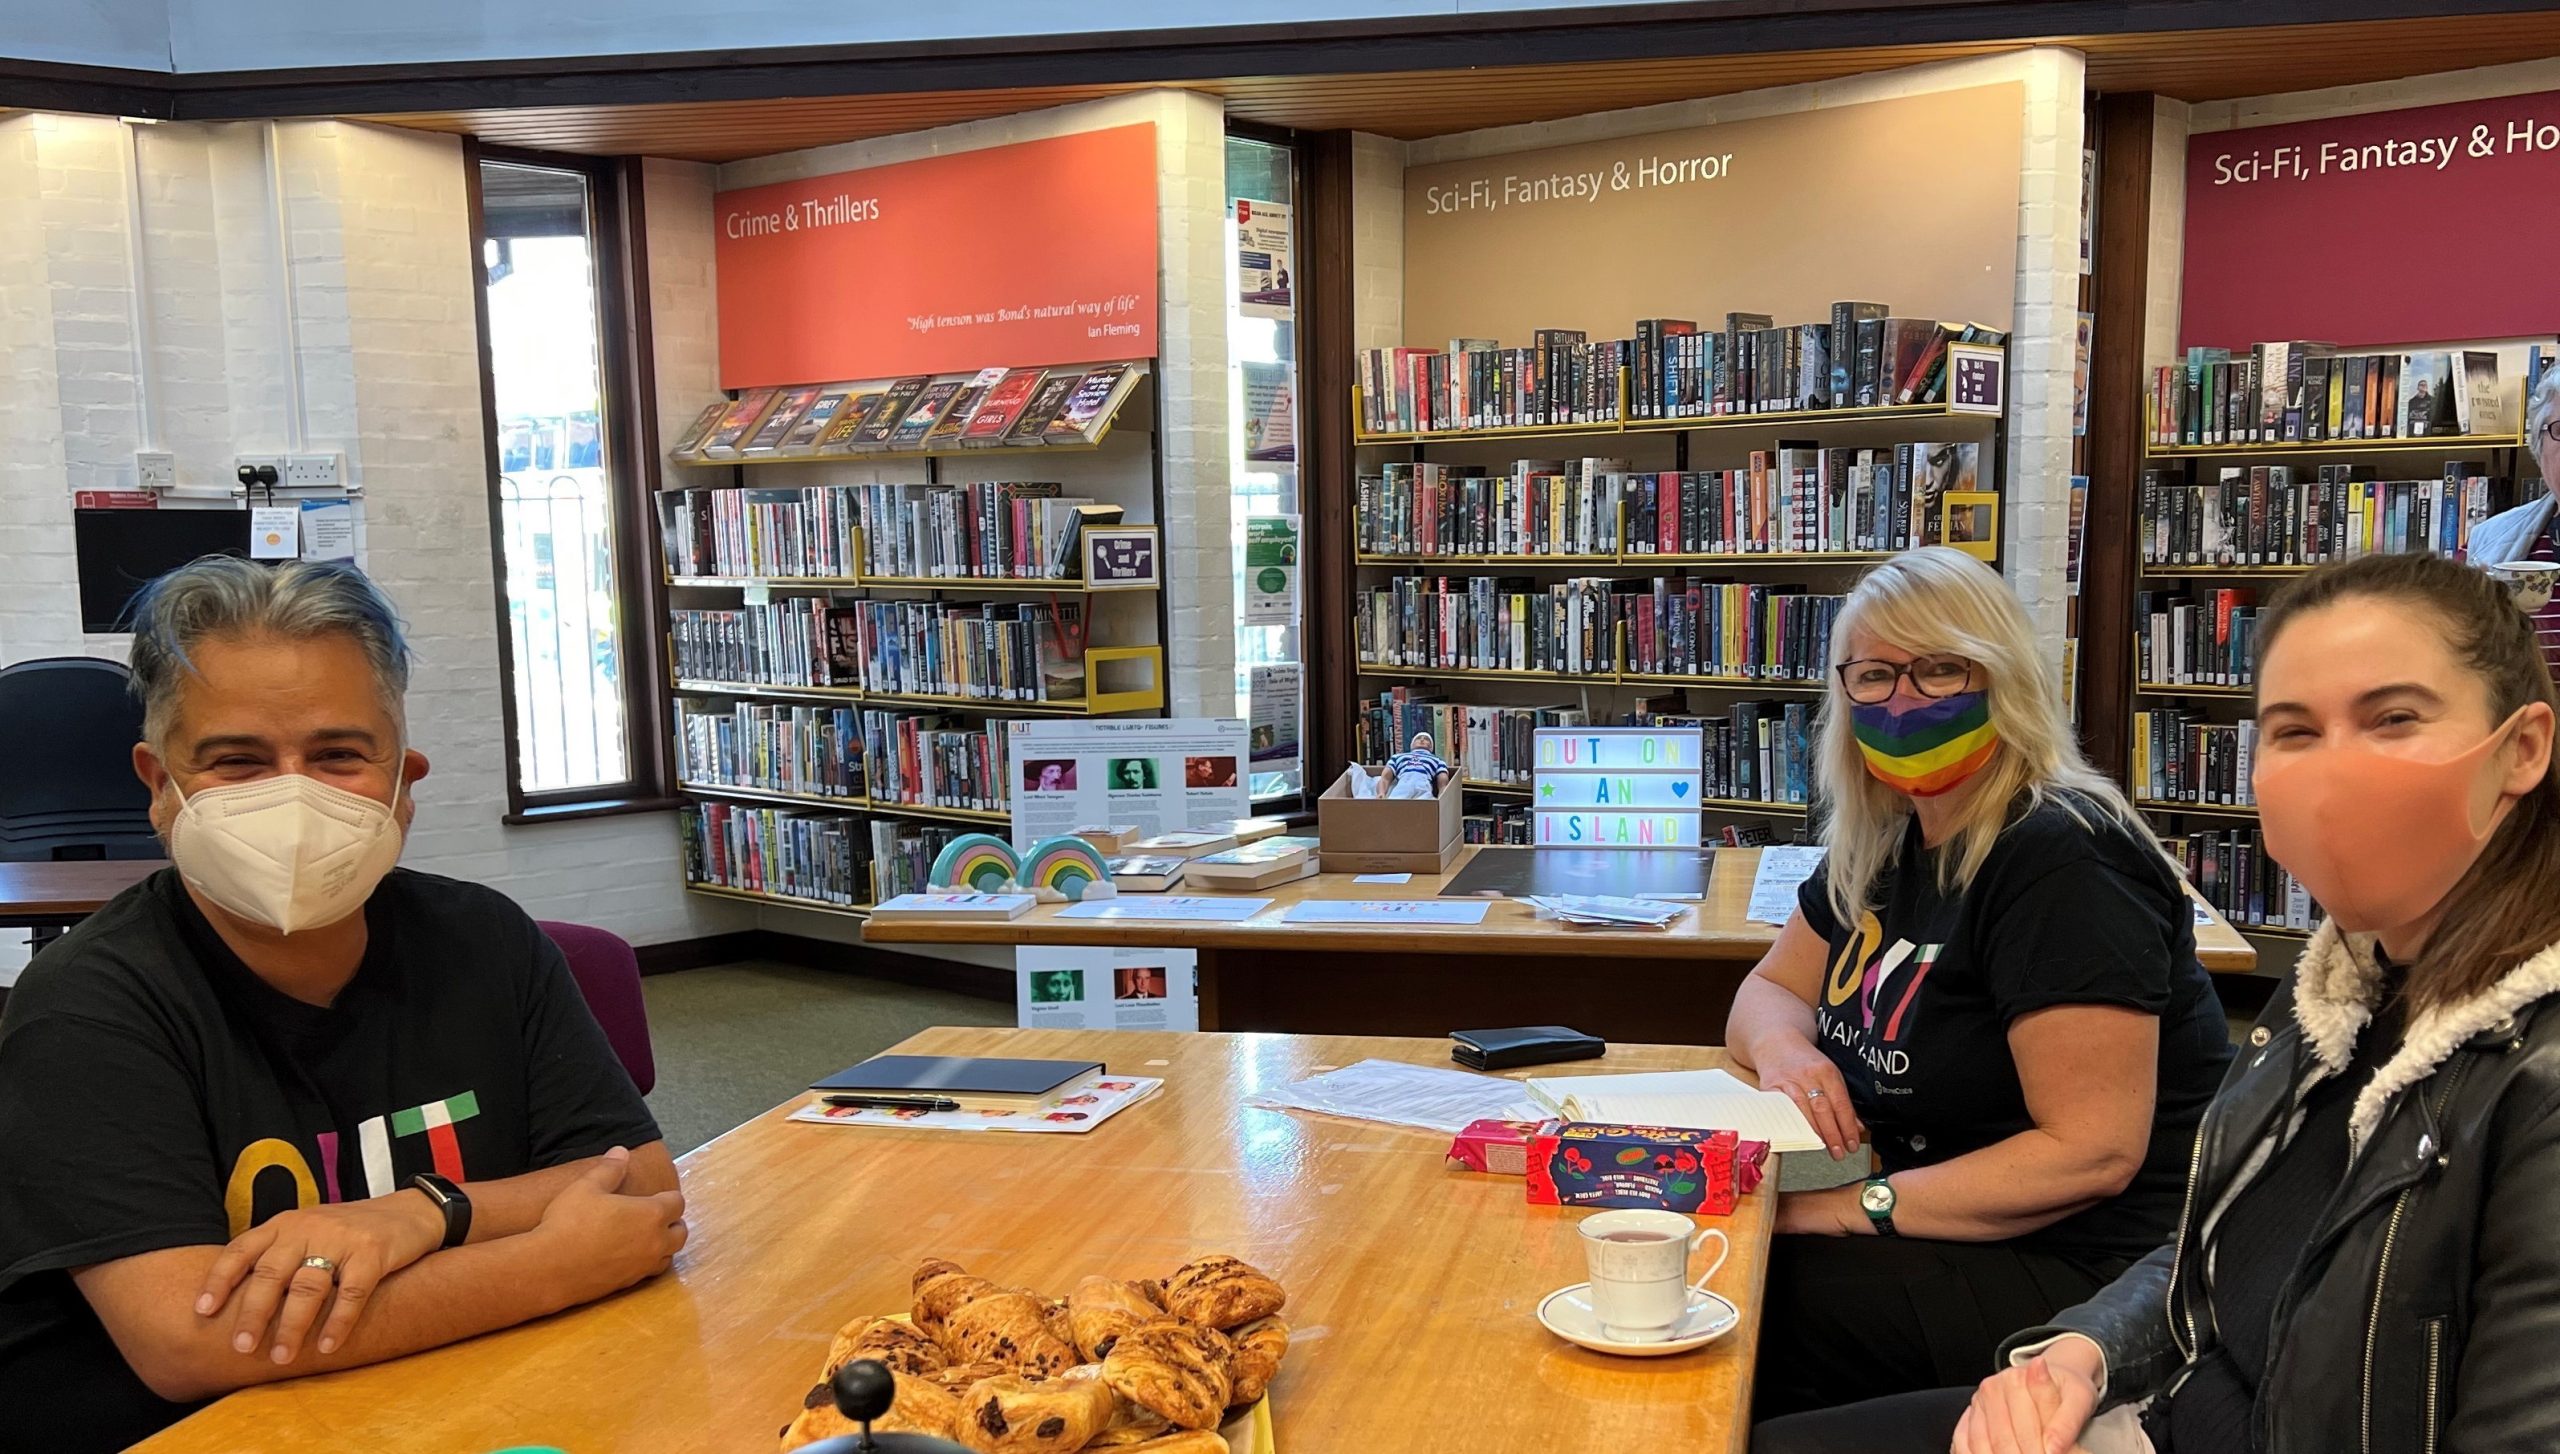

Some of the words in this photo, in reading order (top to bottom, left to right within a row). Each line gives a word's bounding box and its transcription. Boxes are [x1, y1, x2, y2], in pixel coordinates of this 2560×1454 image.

[2214, 146, 2310, 185] Sci-Fi,
[2320, 136, 2459, 174] Fantasy
[2467, 124, 2495, 157] &
[1426, 178, 1498, 213] Sci-Fi,
[1504, 170, 1604, 206] Fantasy
[1610, 161, 1631, 192] &
[1638, 151, 1733, 188] Horror
[727, 210, 780, 239] Crime
[785, 204, 799, 231] &
[802, 195, 880, 229] Thrillers
[936, 314, 973, 330] tension
[975, 311, 994, 324] was
[997, 306, 1031, 323] Bond's
[1033, 301, 1074, 318] natural
[1076, 300, 1102, 318] way
[1104, 297, 1115, 317] of
[1088, 325, 1102, 338] Ian
[1103, 322, 1140, 338] Fleming
[1554, 331, 1583, 344] RITUALS
[1668, 356, 1678, 396] SHIFT
[2188, 365, 2199, 392] DEEP
[976, 414, 1005, 424] GIRLS
[1360, 482, 1368, 512] ASHER
[1438, 468, 1448, 519] PROXIMA
[2445, 475, 2455, 498] ONE
[1034, 607, 1080, 622] MINTTE
[985, 620, 994, 650] SINNER
[1011, 722, 1031, 733] OUT
[1542, 738, 1600, 765] OUT
[1643, 738, 1680, 765] ON
[1596, 778, 1632, 804] AN
[1545, 815, 1678, 844] ISLAND
[1738, 827, 1772, 843] PETER
